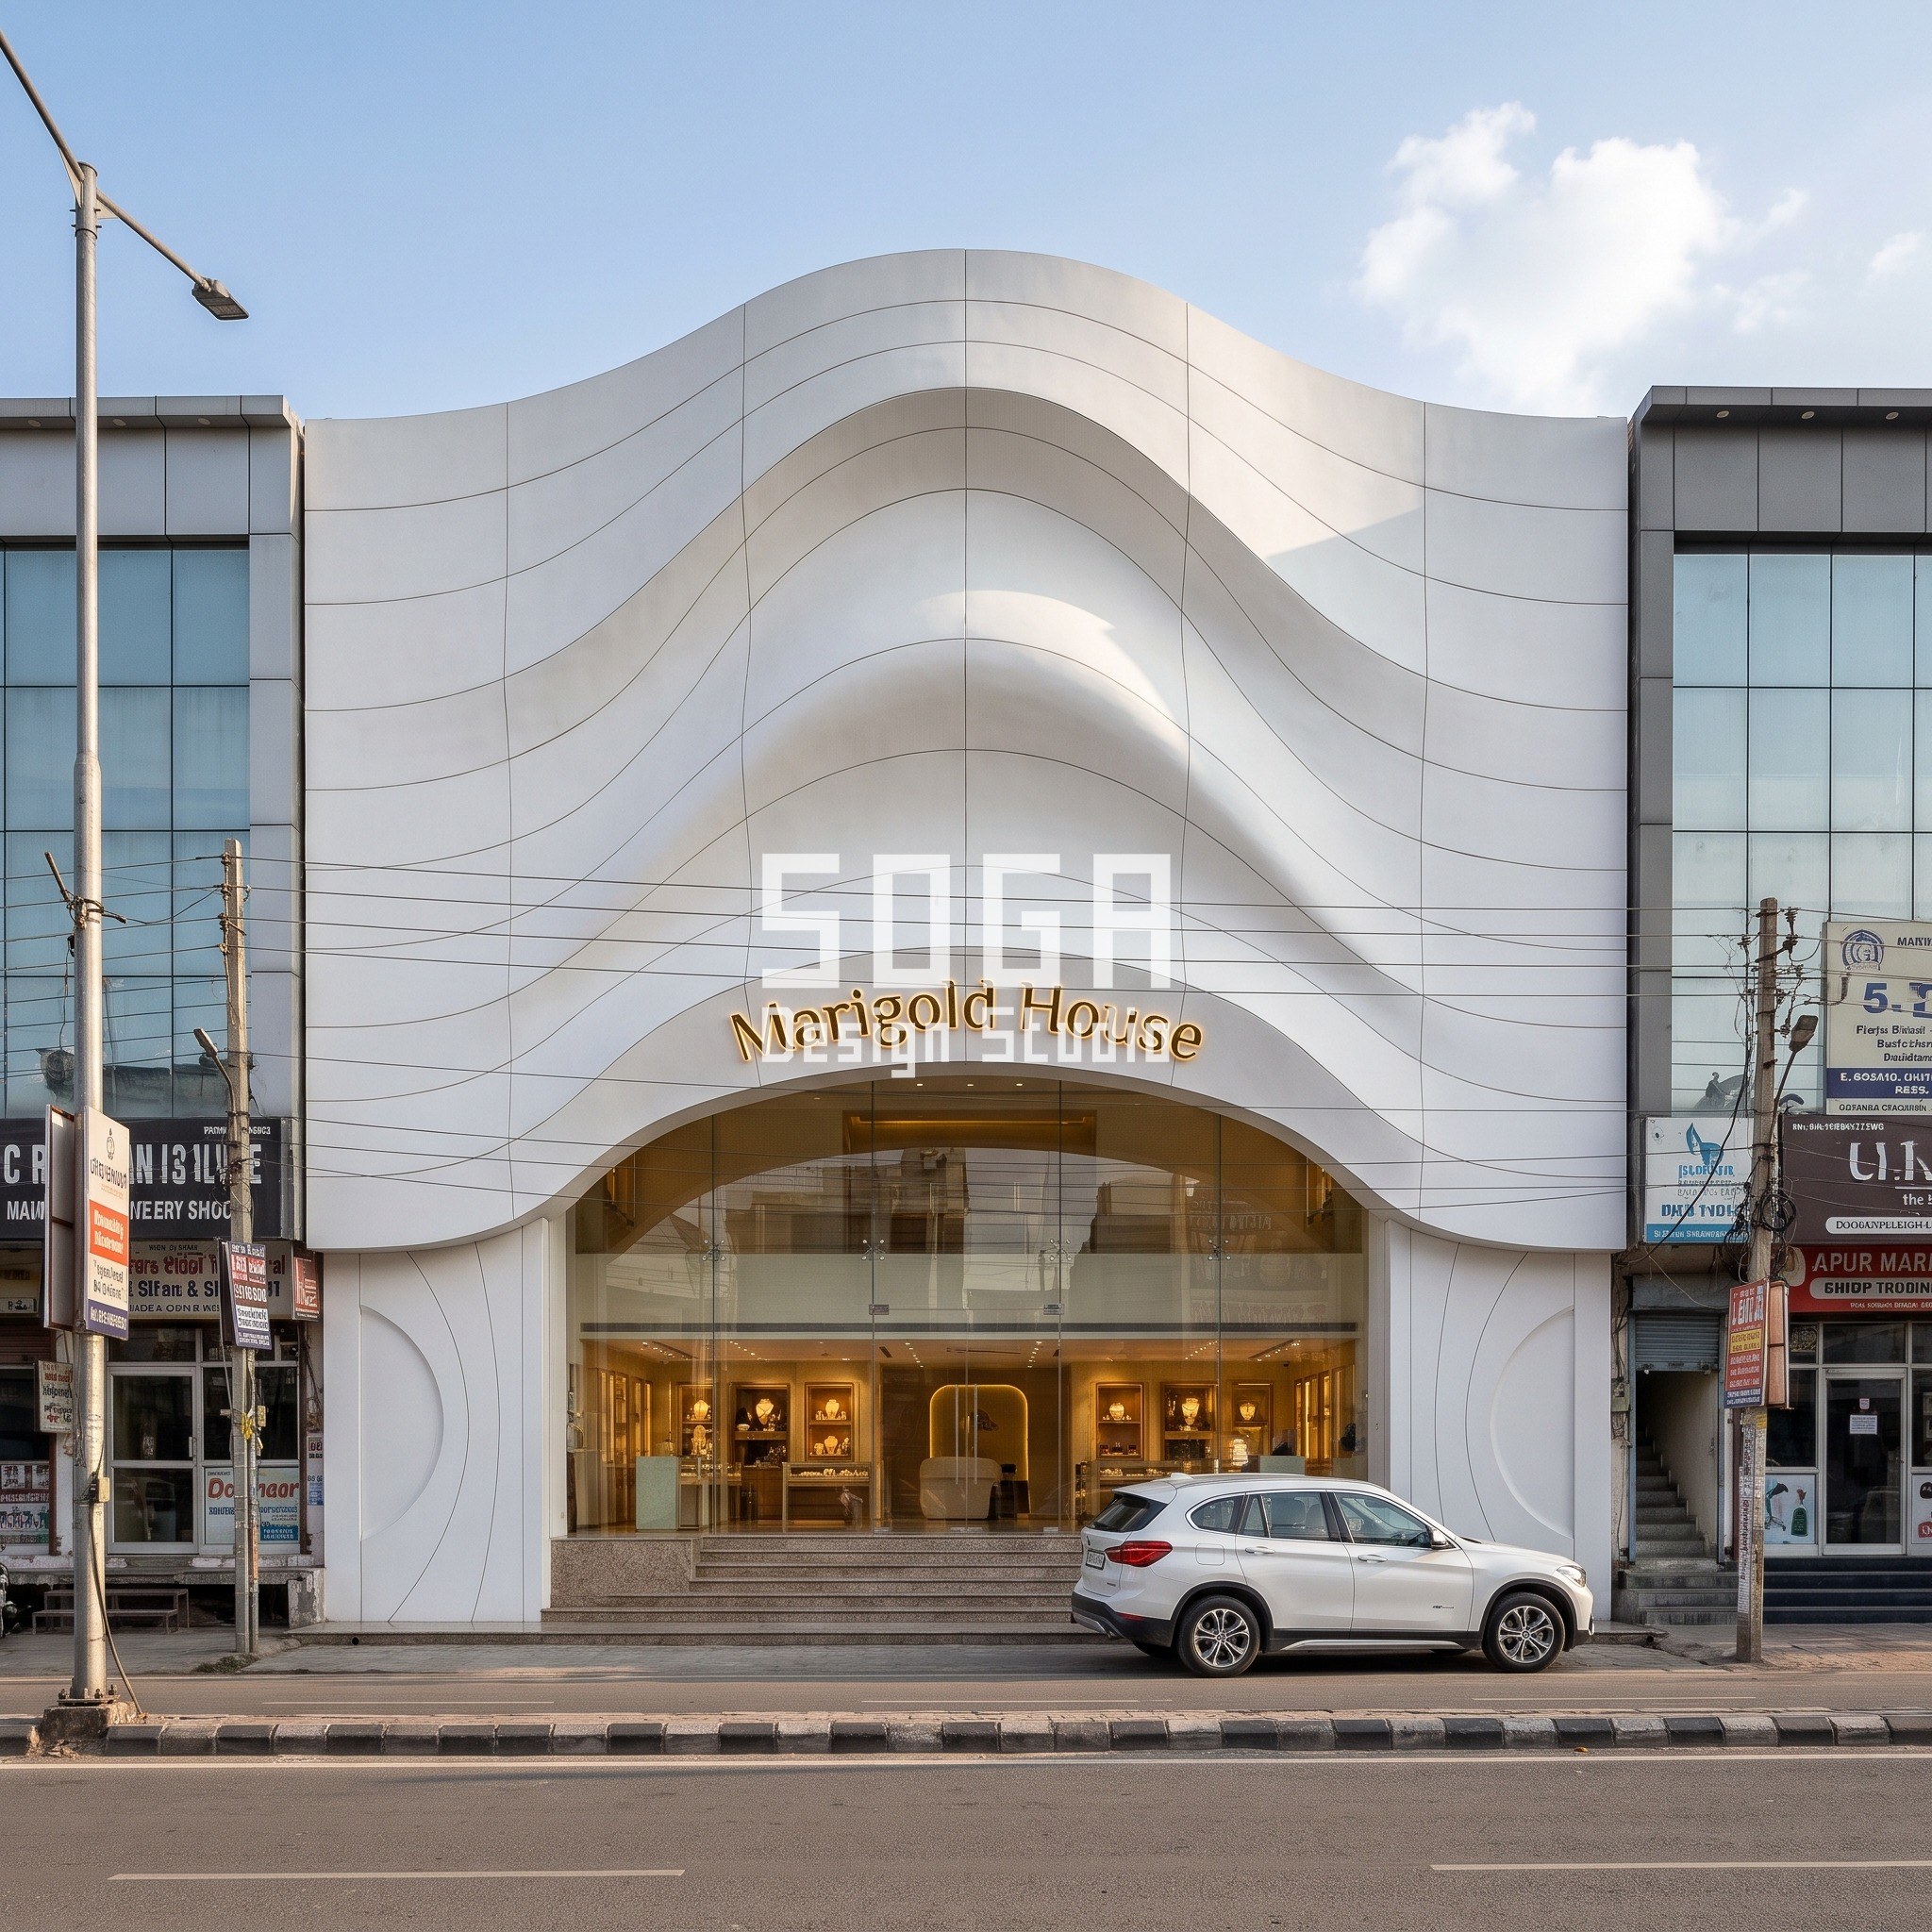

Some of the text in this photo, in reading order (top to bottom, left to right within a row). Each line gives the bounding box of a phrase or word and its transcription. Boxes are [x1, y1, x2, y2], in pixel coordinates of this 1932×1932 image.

[731, 980, 1203, 1061] Marigold House
[1903, 1193, 1924, 1206] the
